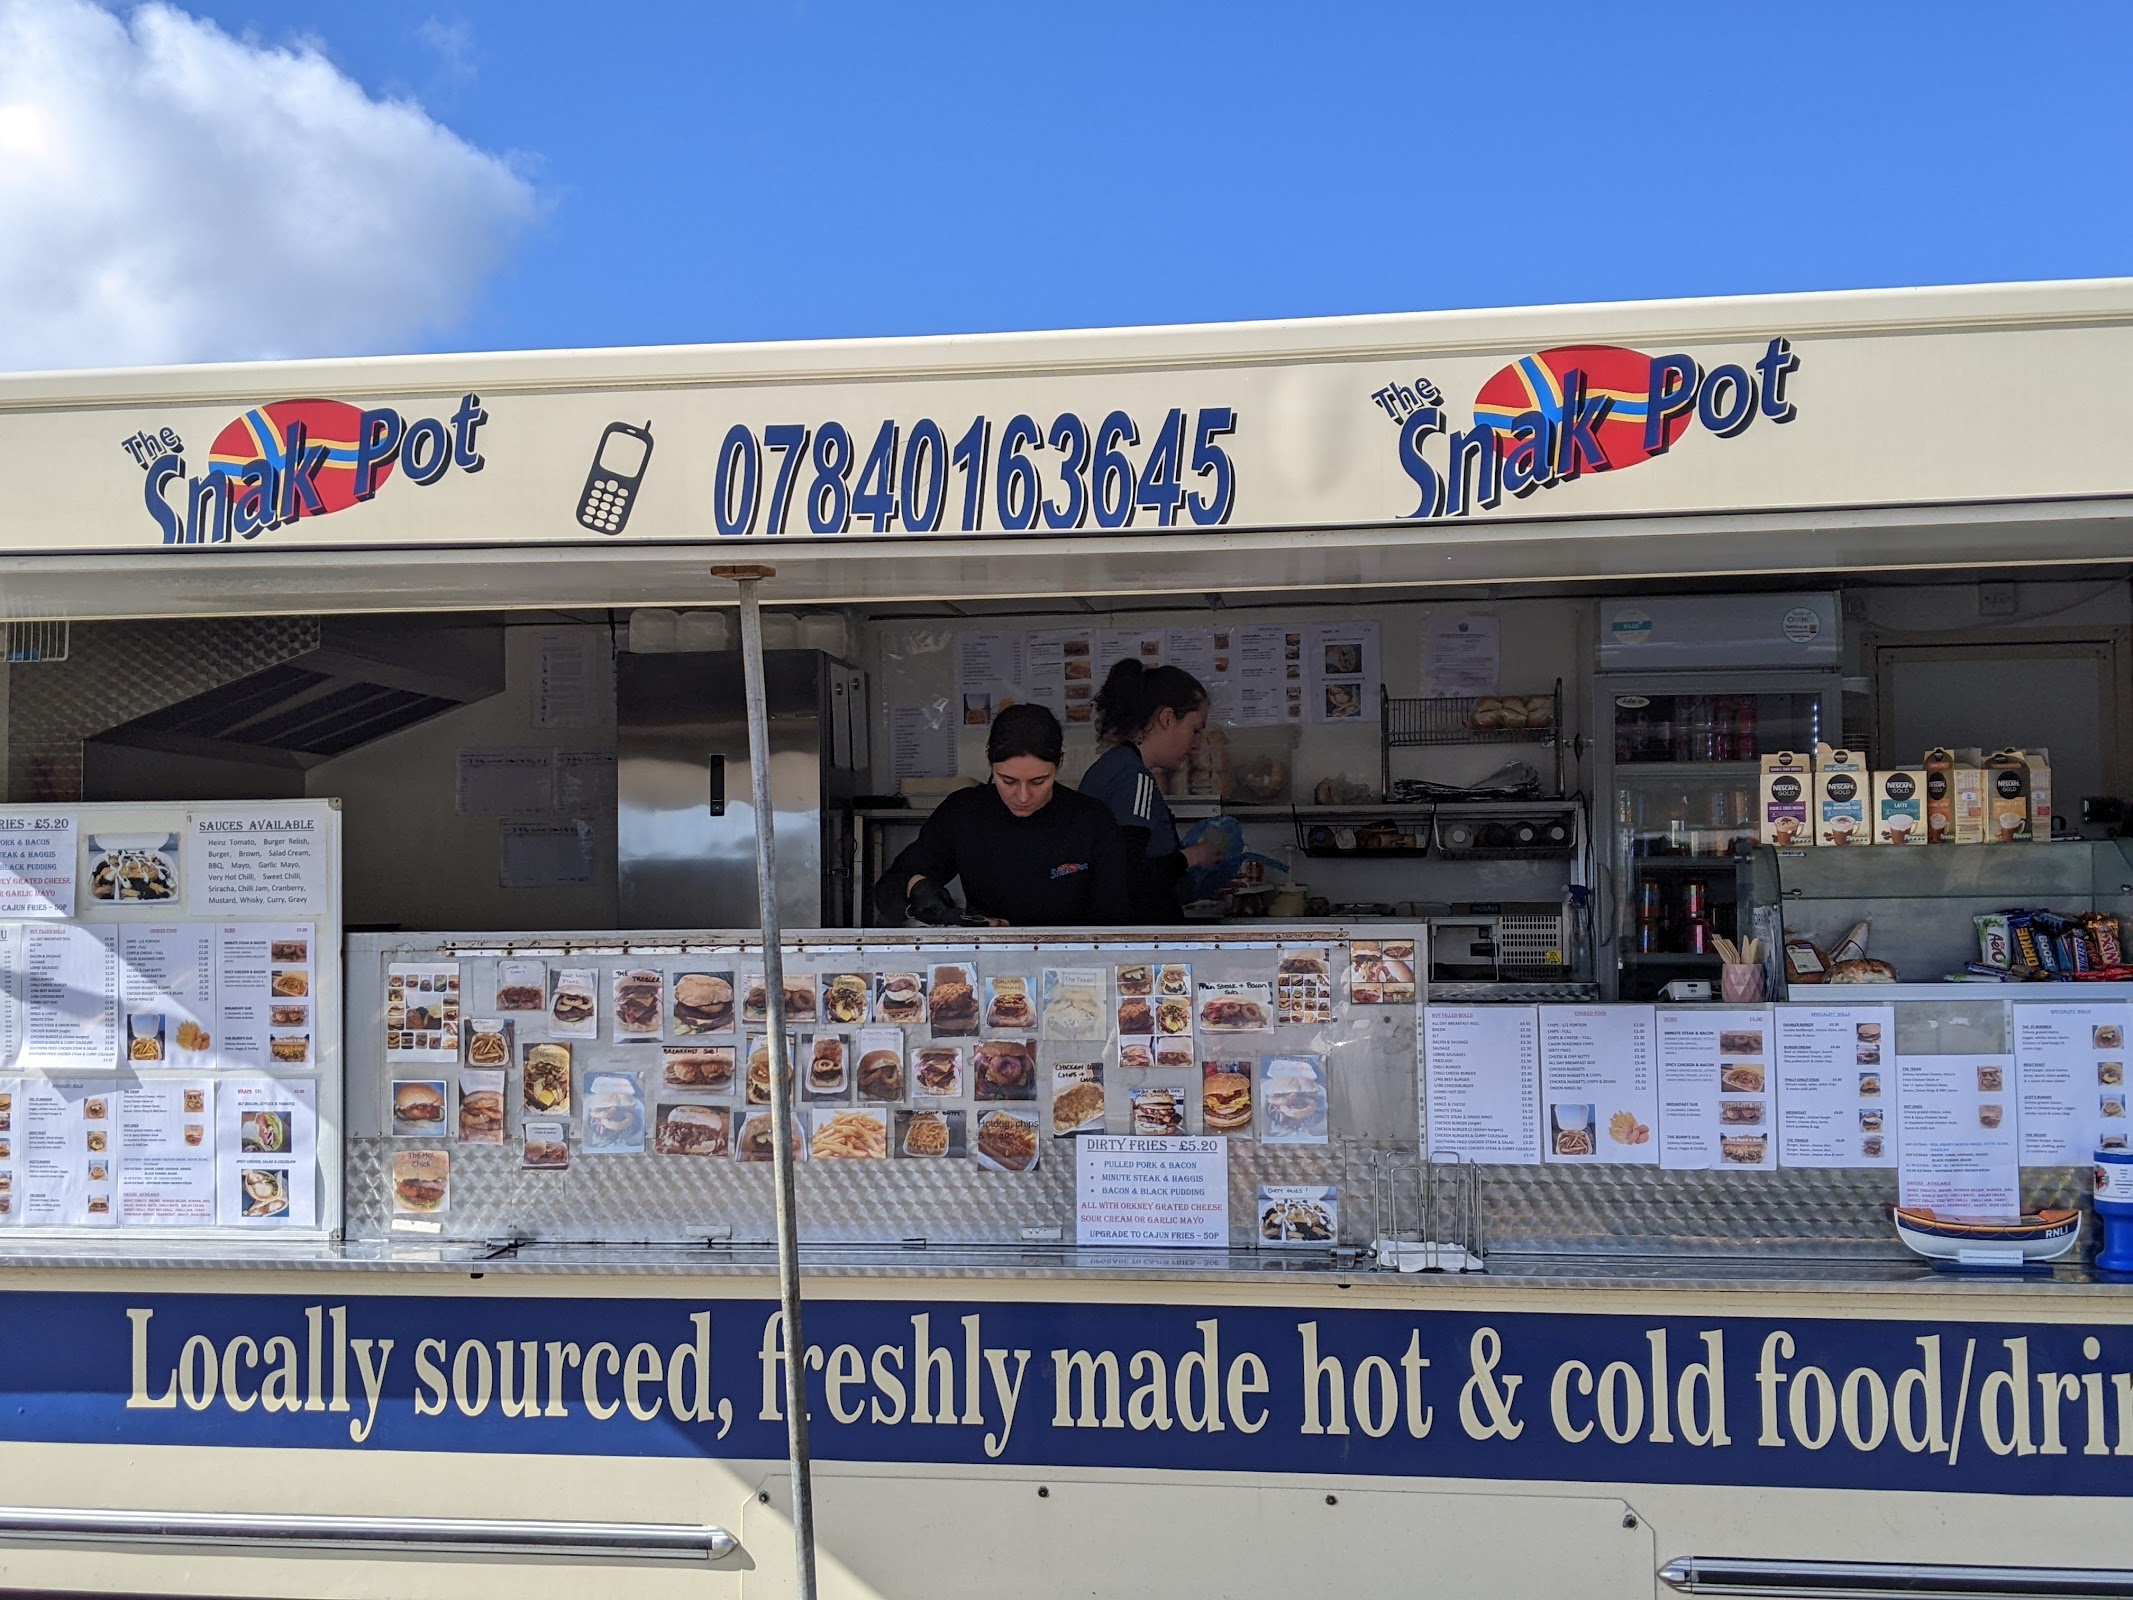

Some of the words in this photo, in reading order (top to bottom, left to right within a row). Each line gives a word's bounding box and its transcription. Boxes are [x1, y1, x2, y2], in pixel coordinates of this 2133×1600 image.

[1371, 374, 1444, 426] The
[1642, 336, 1801, 457] Pot
[121, 423, 184, 471] The
[353, 393, 489, 501] Pot
[1395, 367, 1613, 518] Snak
[713, 408, 1237, 535] 07840163645
[144, 420, 331, 544] Snak
[0, 819, 25, 829] RIES
[34, 818, 69, 829] £5.20
[199, 821, 243, 831] SAUCES
[249, 819, 314, 830] AVAILABLE
[27, 863, 57, 871] PUDDING
[44, 877, 71, 885] CHEESE
[238, 873, 256, 881] Chilli,
[35, 889, 56, 897] MAYO
[288, 896, 307, 904] Gravy
[2015, 927, 2040, 967] ORKIE
[1015, 1120, 1039, 1130] chips
[1087, 1138, 1127, 1150] DIRTY
[1129, 1140, 1167, 1151] FRIES
[1179, 1140, 1218, 1151] £5.20
[412, 1159, 431, 1167] Chick
[1136, 1161, 1157, 1169] PORK
[1102, 1174, 1131, 1182] MINUTE
[1102, 1187, 1129, 1195] BACON
[1170, 1188, 1205, 1196] PUDDING
[1099, 1201, 1118, 1209] WITH
[1120, 1202, 1153, 1210] ORKNEY
[1155, 1203, 1189, 1211] GRATED
[1081, 1215, 1102, 1223] SOUR
[1104, 1215, 1133, 1223] CREAM
[1147, 1216, 1178, 1224] GARLIC
[1180, 1216, 1204, 1224] MAYO
[1090, 1230, 1128, 1238] UPGRADE
[1142, 1231, 1169, 1239] CAJUN
[1203, 1232, 1219, 1240] 50P
[2045, 1226, 2068, 1240] RNLI
[126, 1306, 394, 1443] Locally
[414, 1310, 733, 1441] sourced,
[758, 1311, 1031, 1458] freshly
[1052, 1319, 1269, 1433] made
[1298, 1321, 1433, 1439] hot
[1459, 1327, 1524, 1440] &
[1550, 1328, 1732, 1447] cold
